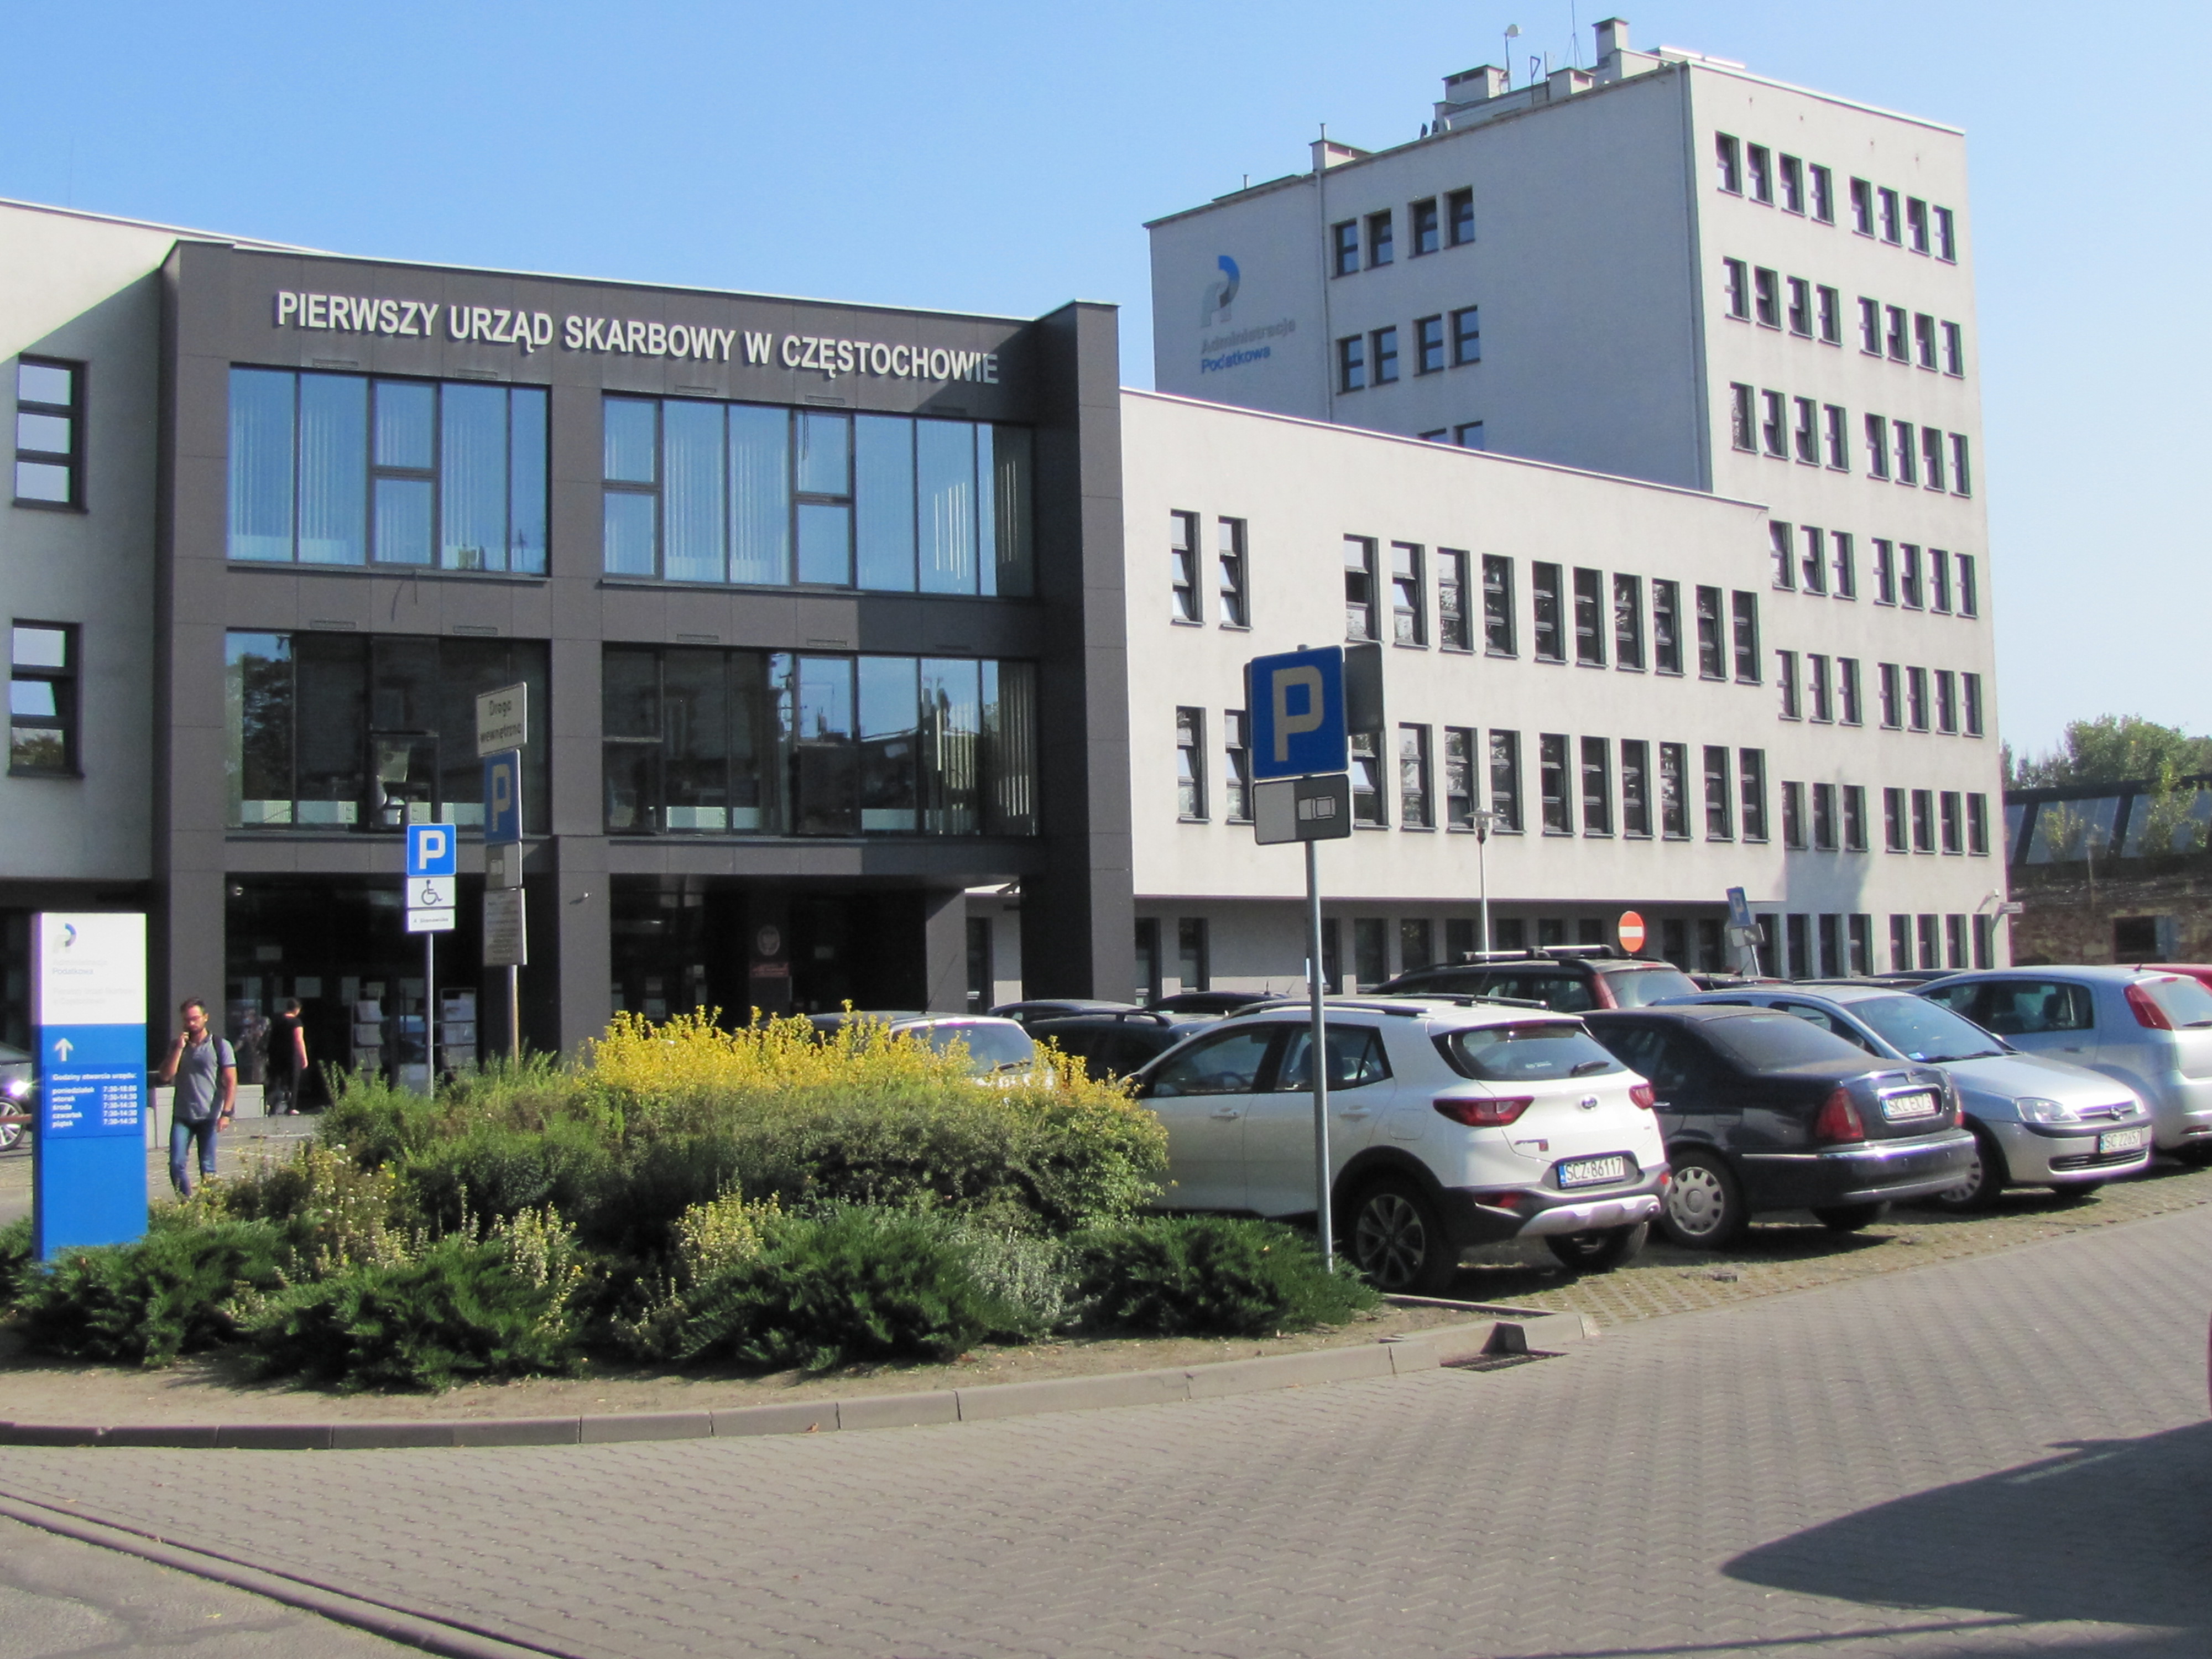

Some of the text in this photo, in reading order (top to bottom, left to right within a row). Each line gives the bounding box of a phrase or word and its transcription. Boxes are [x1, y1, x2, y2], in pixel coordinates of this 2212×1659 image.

[278, 291, 998, 384] PIERWSZY URZĄD SKARBOWY W CZĘSTOCHOWIE
[1201, 318, 1296, 354] Administracja
[1201, 346, 1270, 374] Podatkowa
[489, 700, 512, 717] Droga
[1272, 665, 1324, 762] P
[481, 723, 521, 743] wewnętrzna
[492, 763, 511, 832] P
[419, 829, 446, 870] P
[1566, 1158, 1621, 1180] SCZ 86117
